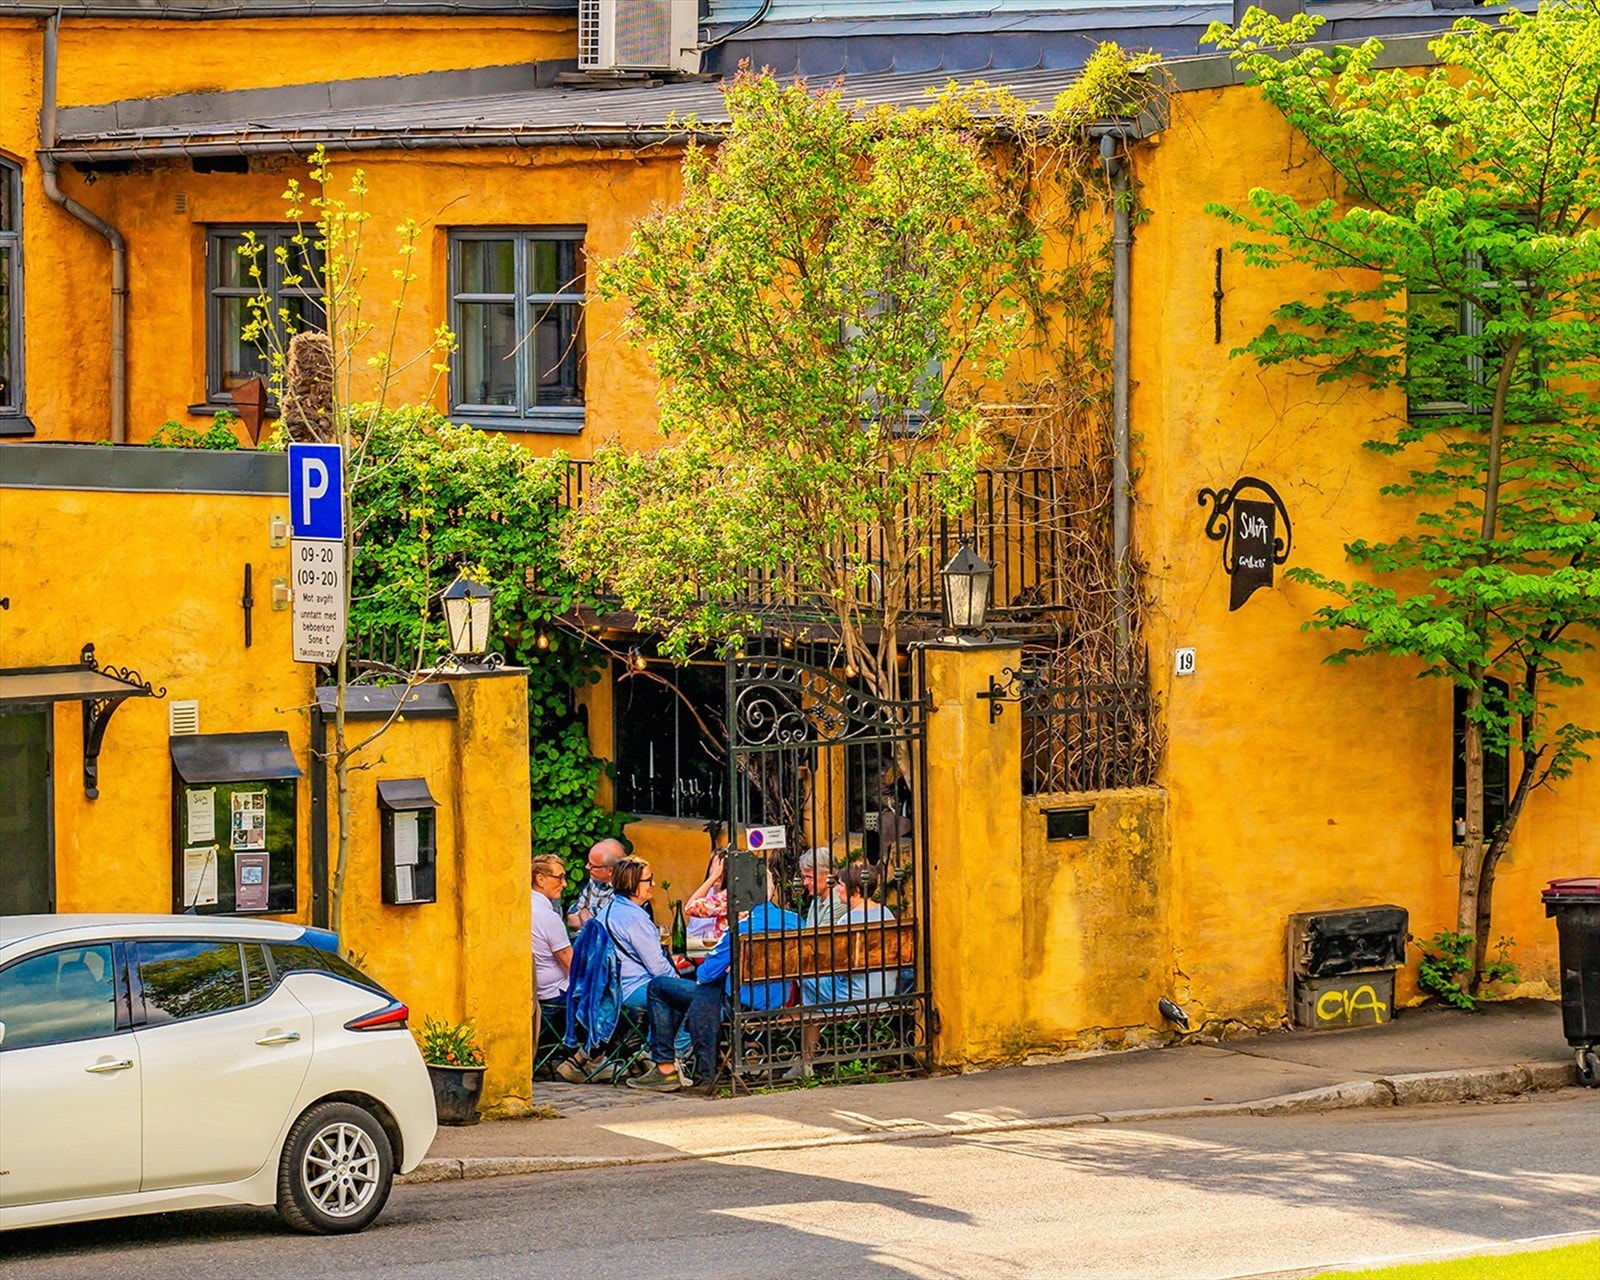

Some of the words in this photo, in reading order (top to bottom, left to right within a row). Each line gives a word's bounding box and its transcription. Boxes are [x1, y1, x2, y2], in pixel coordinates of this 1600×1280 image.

[302, 457, 329, 525] P
[301, 547, 333, 563] 09-20
[297, 568, 338, 588] (09-20)
[302, 593, 314, 602] Mot
[316, 594, 334, 605] avgift
[300, 610, 322, 619] unntatt
[324, 611, 337, 621] med
[302, 622, 335, 633] beboerkort
[308, 634, 323, 645] Sone
[325, 635, 330, 645] C
[1180, 653, 1193, 670] 19
[1316, 985, 1387, 1024] CIA
